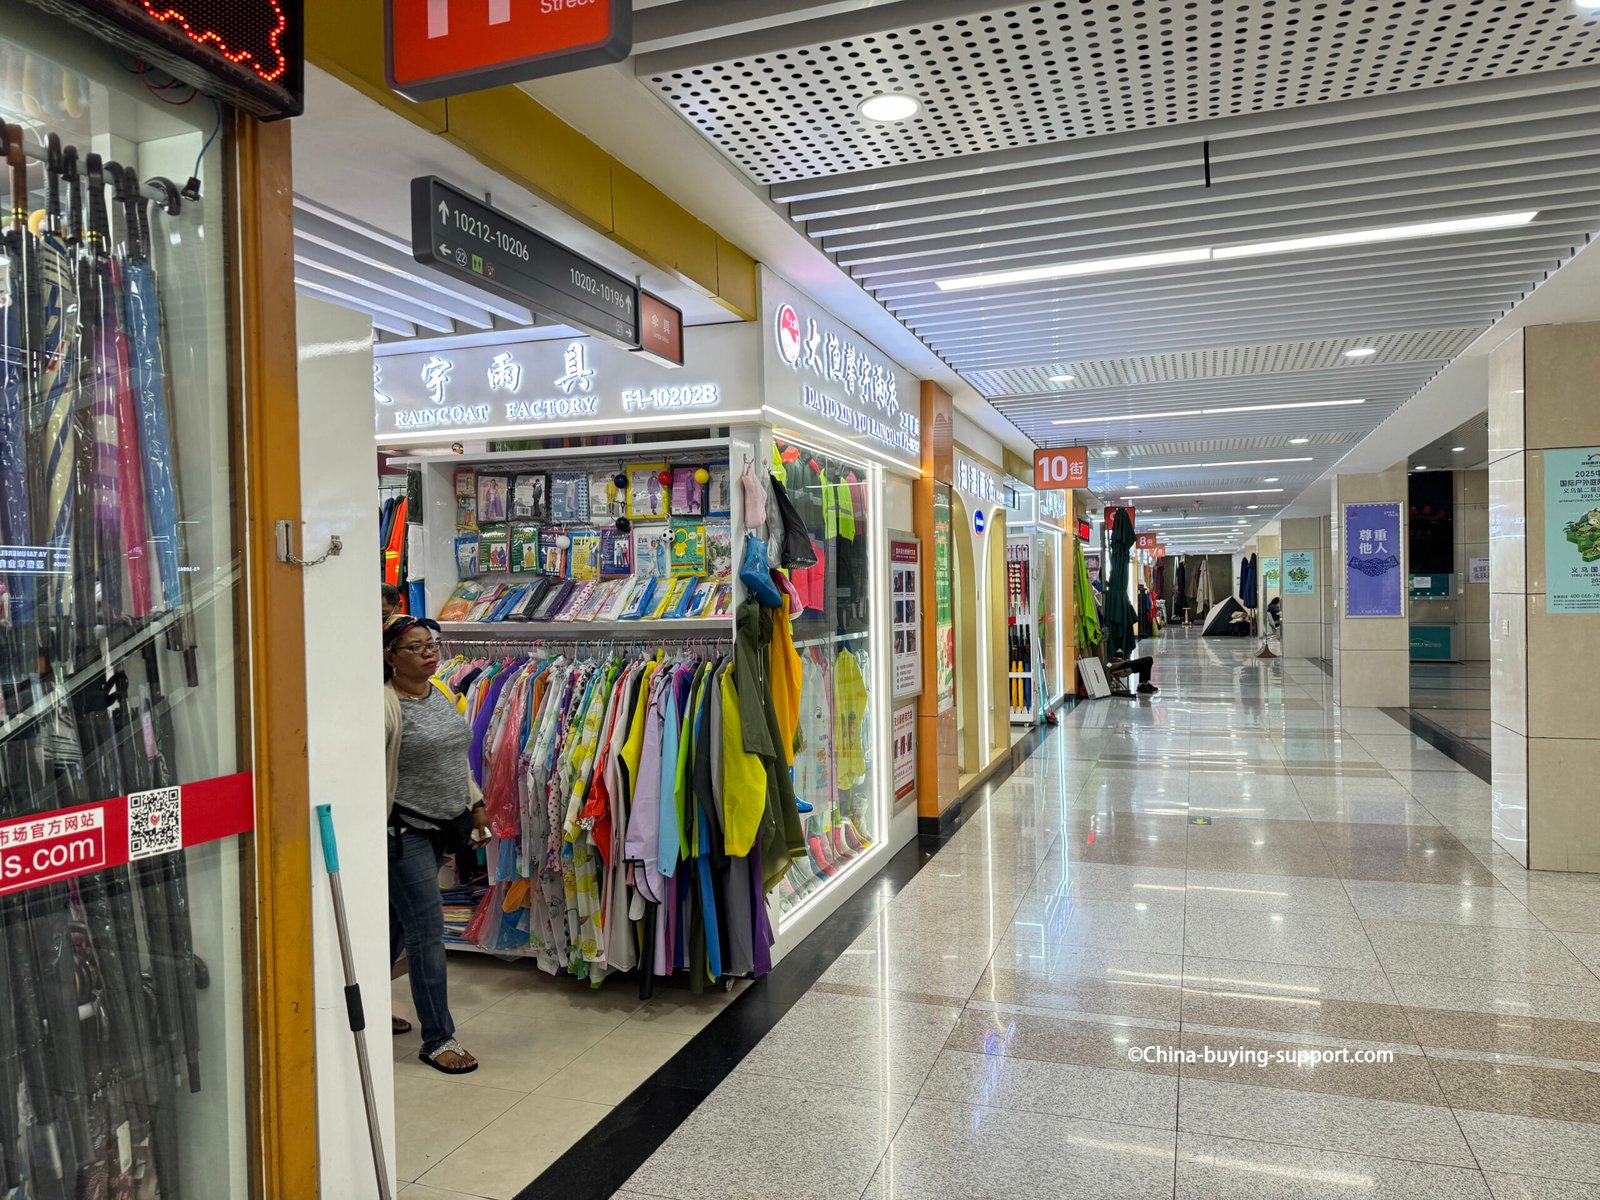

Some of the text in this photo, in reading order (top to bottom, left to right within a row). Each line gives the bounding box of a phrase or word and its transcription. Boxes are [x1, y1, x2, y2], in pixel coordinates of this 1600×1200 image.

[453, 209, 530, 262] 10212-10206
[457, 252, 467, 264] 22
[569, 267, 625, 309] 10202-10196
[394, 396, 599, 428] RAINCOAT FACTORY
[621, 384, 719, 411] F1-10202B
[804, 385, 820, 411] DA
[821, 395, 836, 417] YU
[1038, 455, 1084, 482] 10 街
[1139, 536, 1147, 546] 8
[1359, 528, 1387, 542] 尊重
[1359, 542, 1388, 555] 他人
[0, 812, 95, 846] 市场官方网站
[0, 837, 95, 881] s.com
